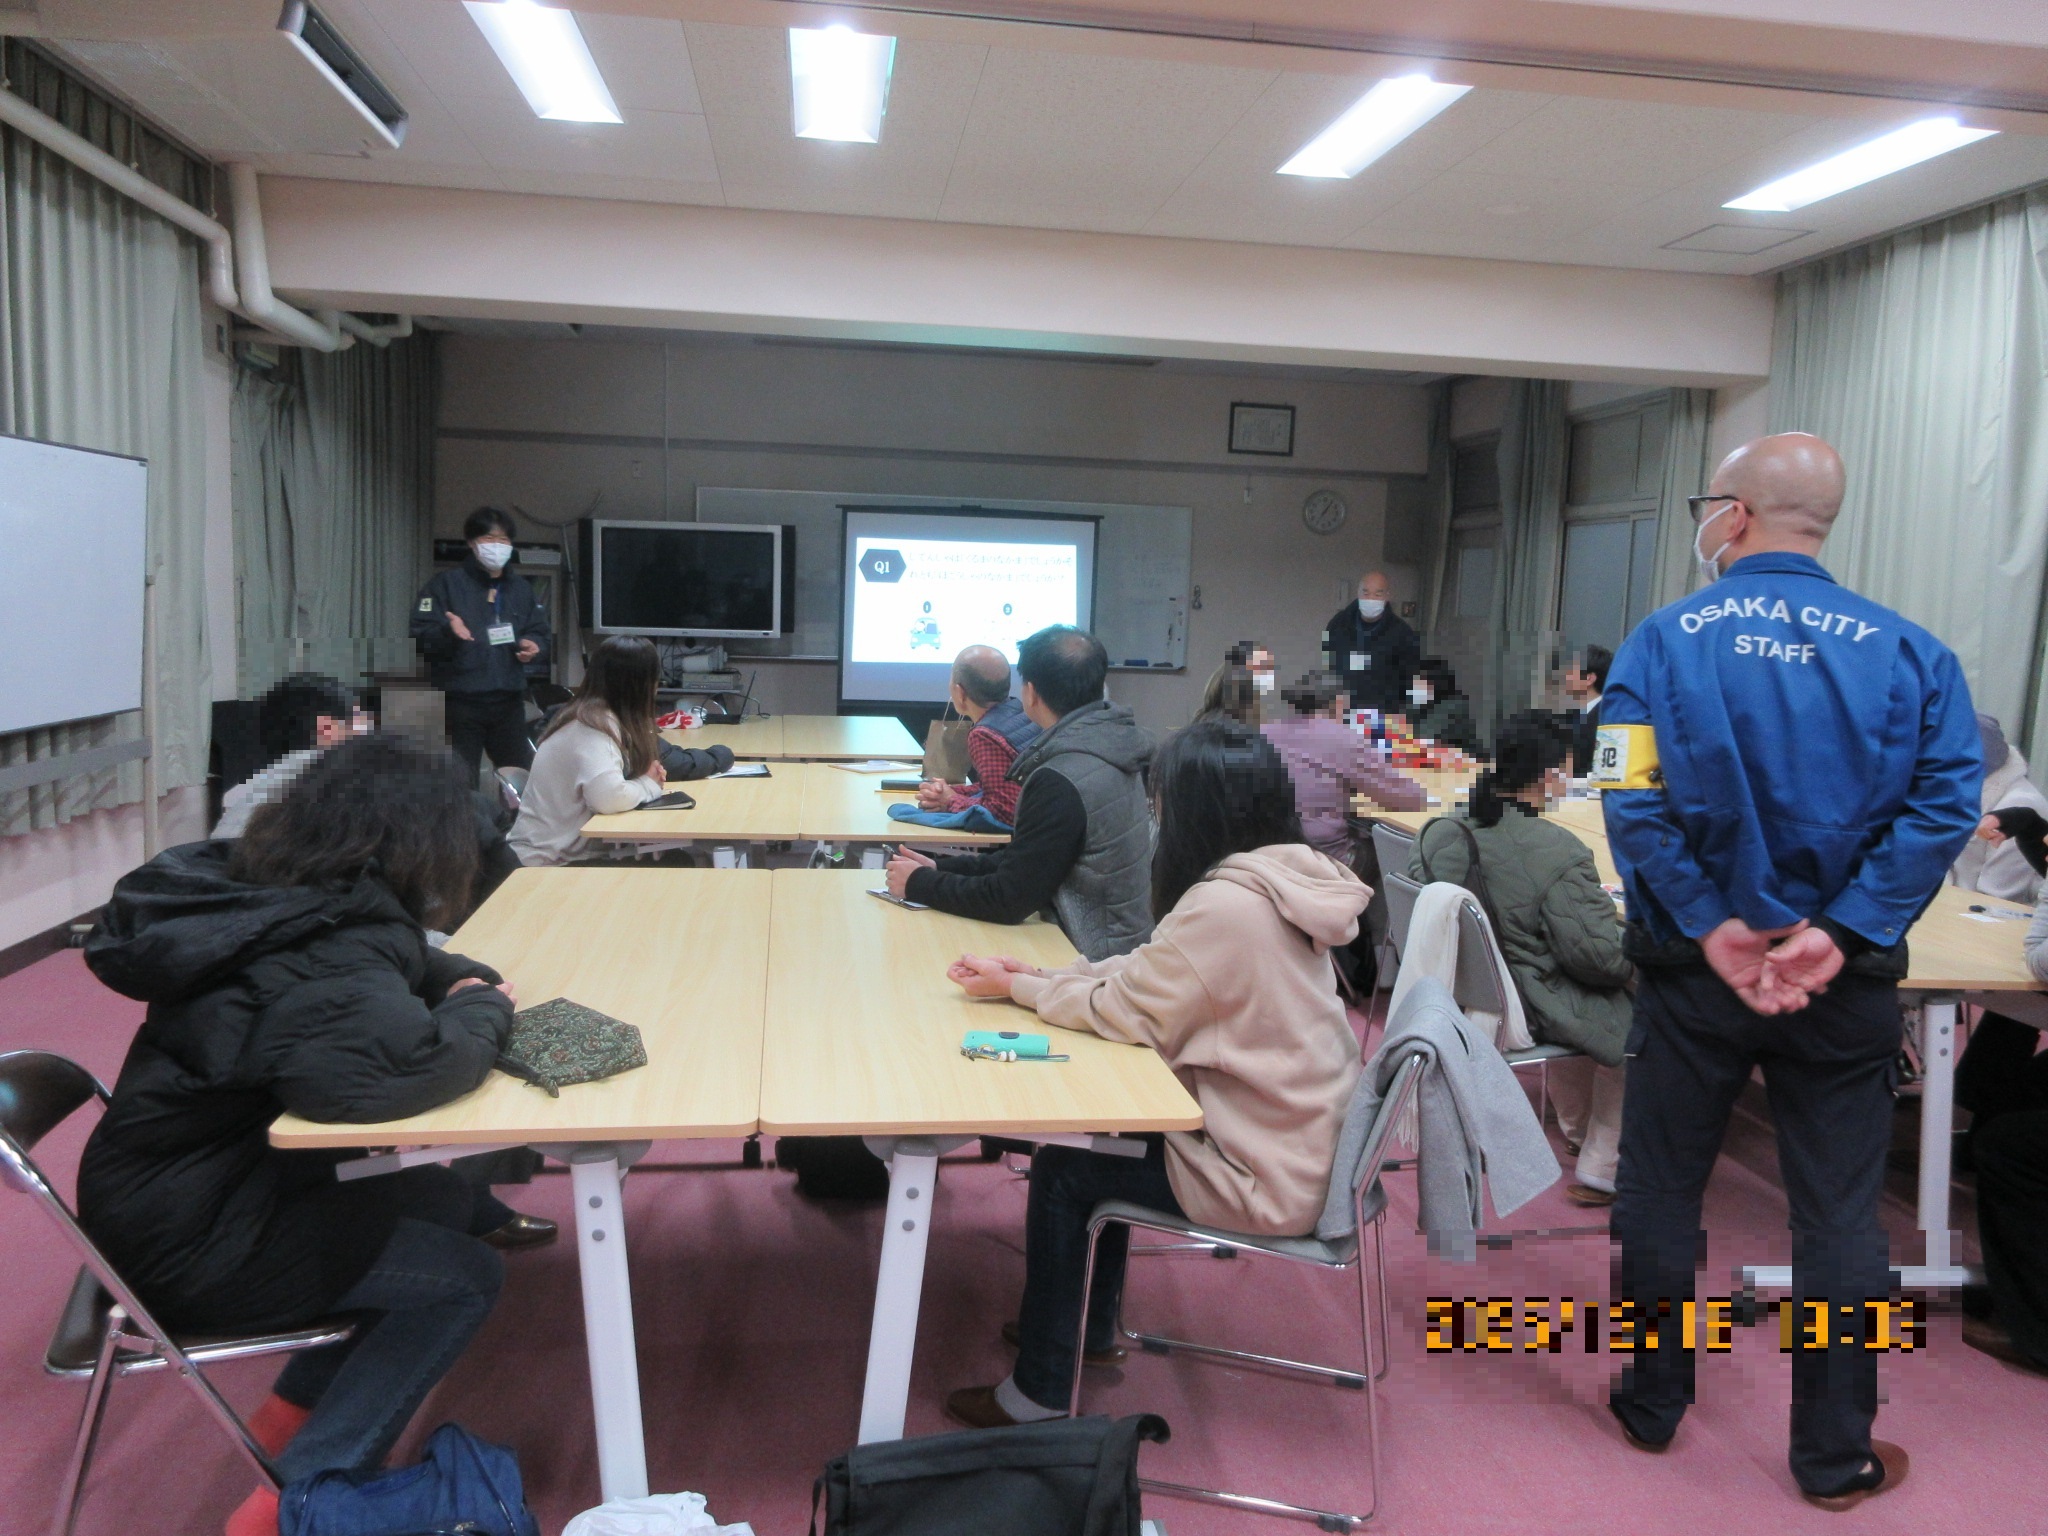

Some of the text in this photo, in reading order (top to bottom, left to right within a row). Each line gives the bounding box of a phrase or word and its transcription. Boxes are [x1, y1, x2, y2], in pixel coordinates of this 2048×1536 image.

[874, 560, 890, 575] Q1
[1679, 596, 1881, 643] OSAKA CITY
[1733, 634, 1816, 665] STAFF
